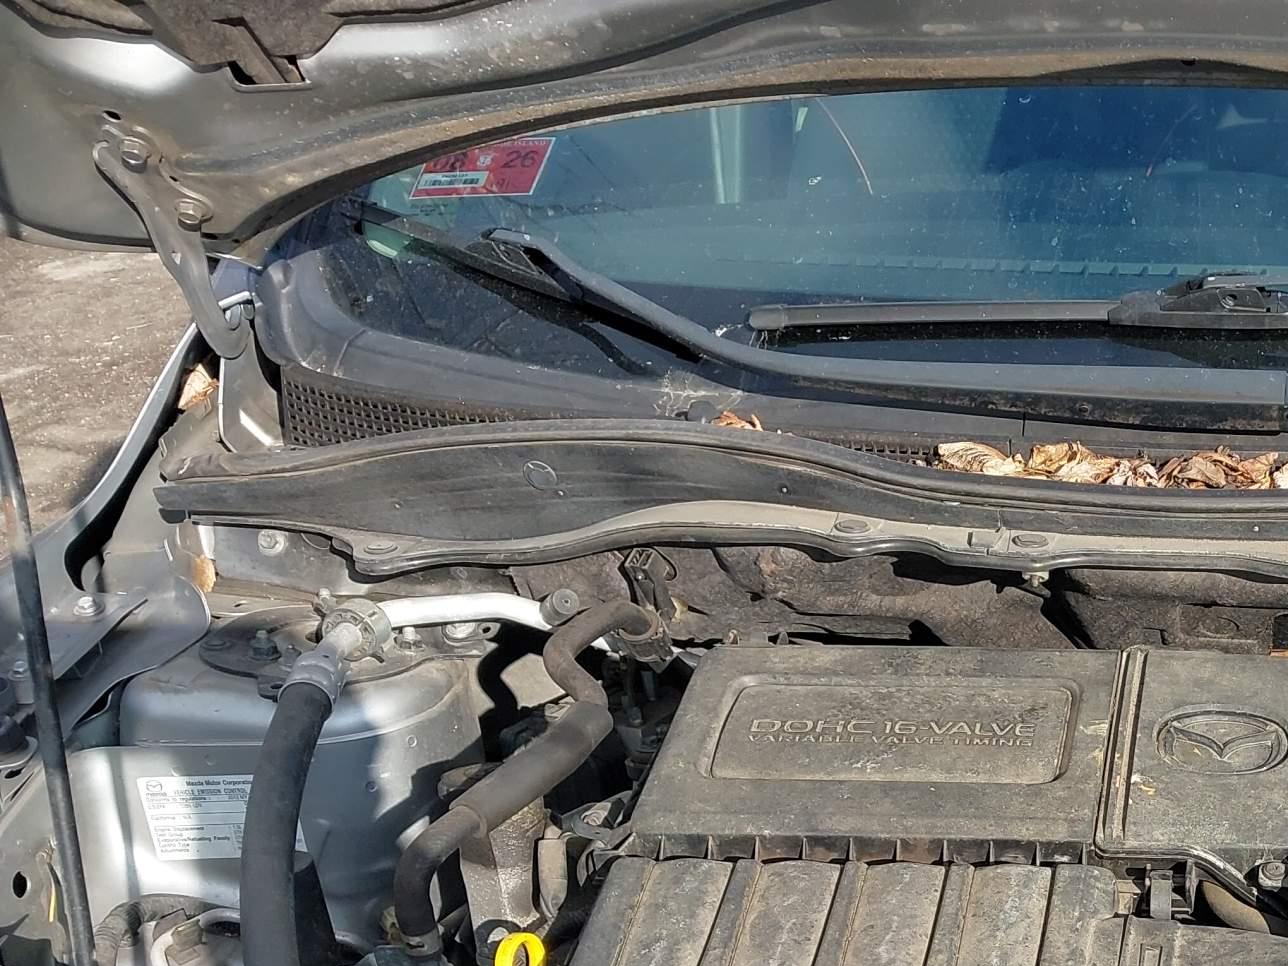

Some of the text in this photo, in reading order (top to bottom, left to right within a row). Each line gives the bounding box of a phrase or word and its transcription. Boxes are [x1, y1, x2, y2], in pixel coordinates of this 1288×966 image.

[750, 719, 1036, 737] DOHC 16-VALVE
[748, 735, 1033, 747] VARIABLE VALVE TIMING
